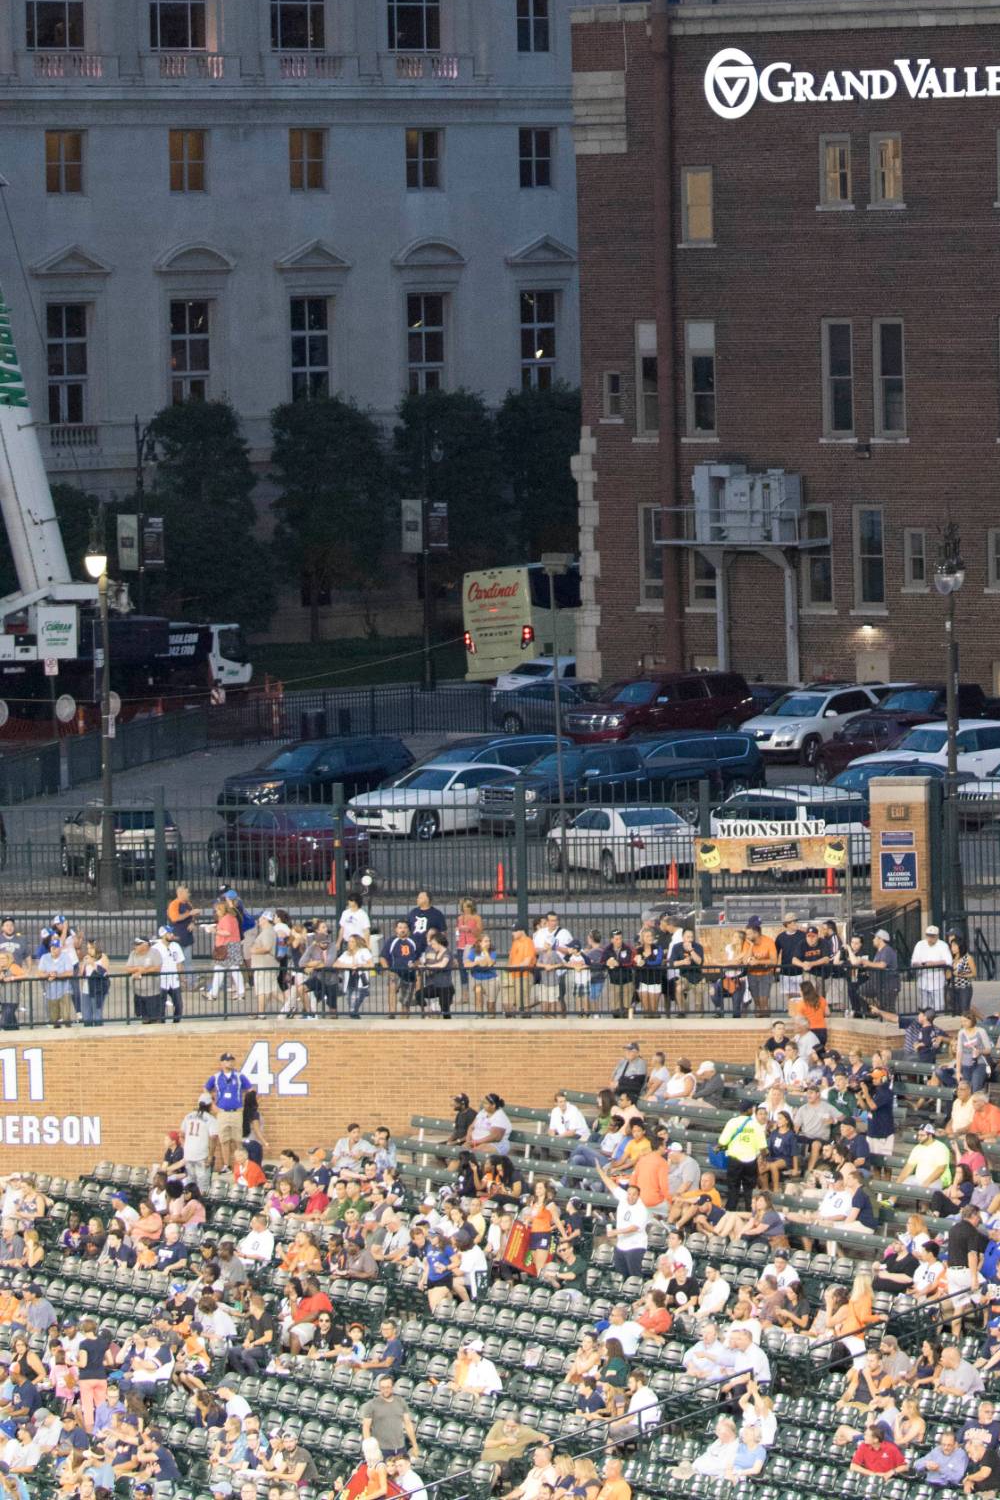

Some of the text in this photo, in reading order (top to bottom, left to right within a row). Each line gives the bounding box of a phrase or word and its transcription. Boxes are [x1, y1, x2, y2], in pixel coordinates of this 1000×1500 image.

[758, 62, 898, 103] GRAND
[467, 581, 520, 602] Cardinal
[719, 822, 824, 837] MOONSHINE
[0, 1047, 45, 1100] 11
[239, 1040, 309, 1095] 42
[0, 1115, 101, 1145] ERSON
